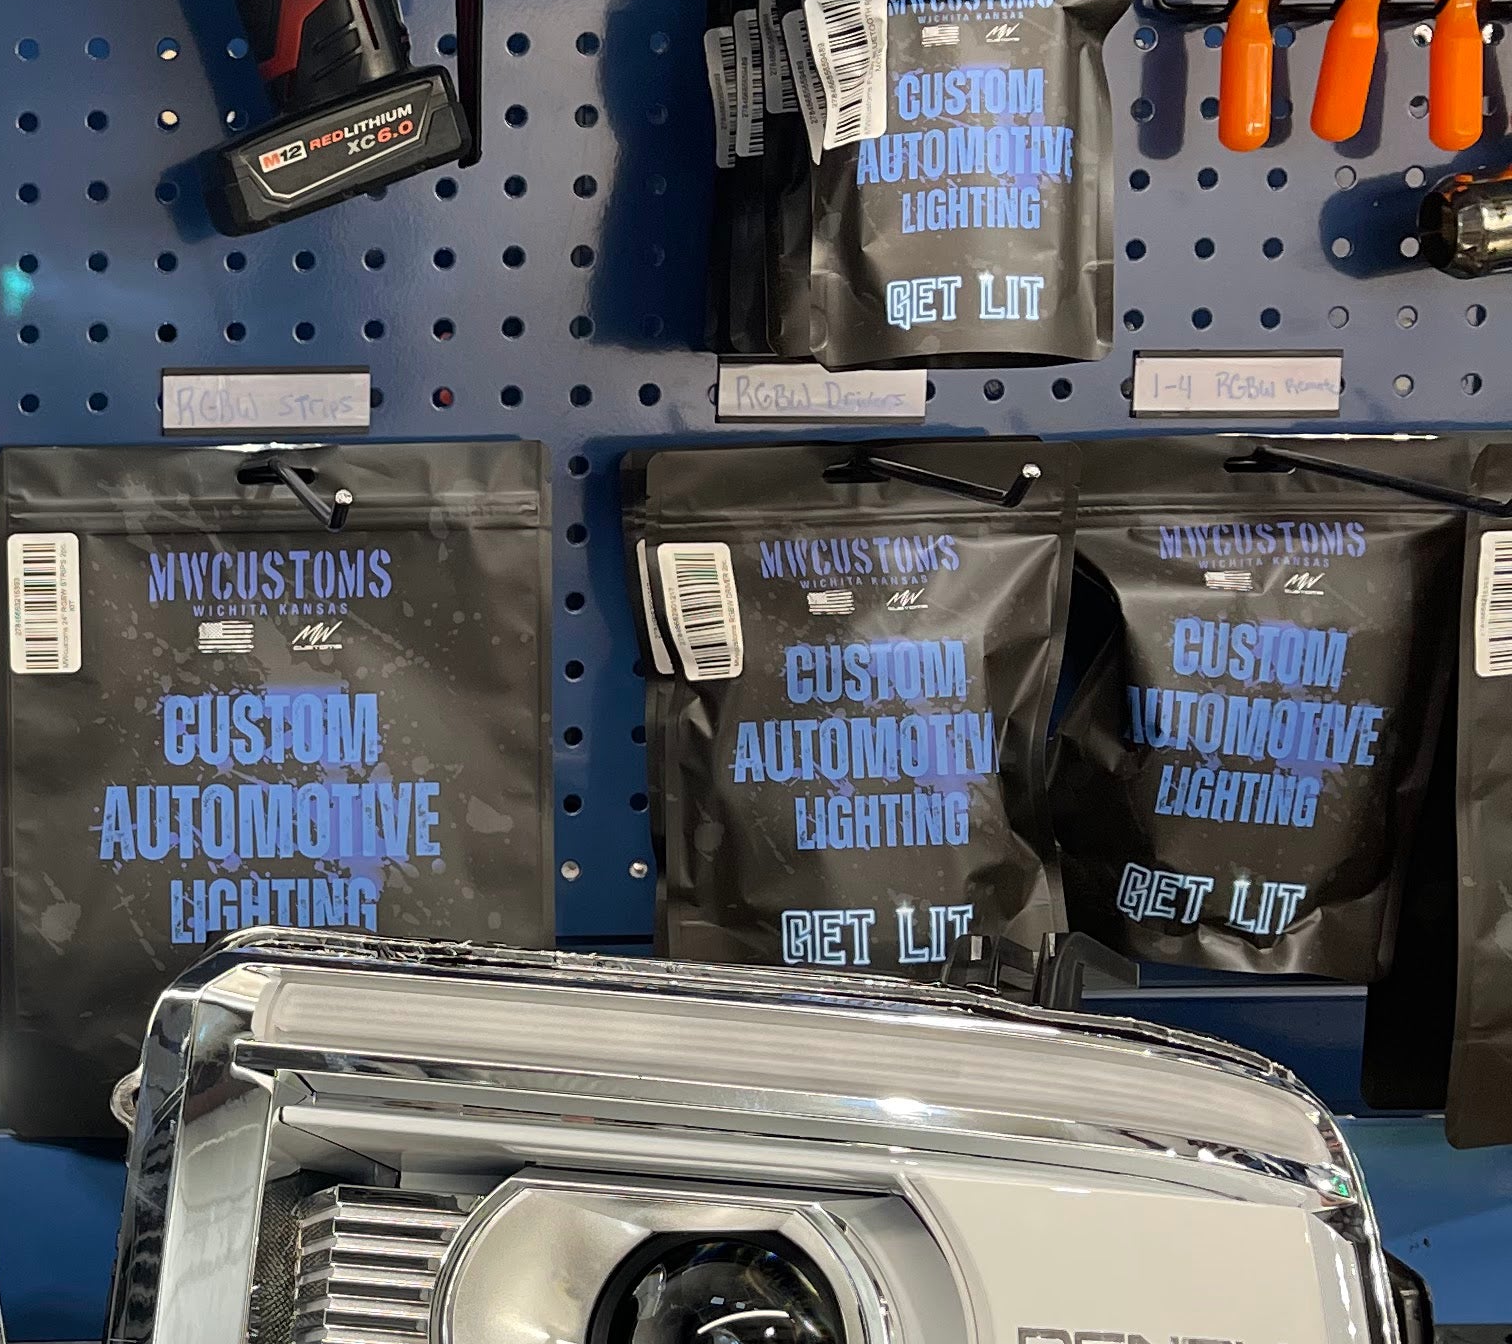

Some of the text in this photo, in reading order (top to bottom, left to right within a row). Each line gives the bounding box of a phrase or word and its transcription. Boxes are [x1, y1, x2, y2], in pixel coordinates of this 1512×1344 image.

[917, 11, 1025, 24] WICHITA KANSAS
[898, 68, 1045, 121] CUSTOM
[262, 104, 413, 169] M12 REDLITHIUM
[347, 120, 415, 156] XC6.0
[901, 186, 1042, 234] LIGHTING
[886, 272, 1046, 331] GET LIT
[176, 385, 260, 427] RGBW
[735, 374, 812, 411] RGBW
[1153, 372, 1193, 400] 1-4
[1215, 371, 1276, 401] RGBW
[759, 534, 961, 579] MWCUSTOMS
[1159, 521, 1367, 561] MWCUSTOMS
[1199, 556, 1331, 570] WICHITA KANSAS
[149, 549, 393, 602] MWCUSTOMS
[800, 574, 929, 590] WICHITA KANSAS
[193, 602, 349, 617] WICHITA KANSAS
[785, 640, 967, 704] CUSTOM
[1172, 616, 1348, 689] CUSTOM
[163, 692, 379, 765] CUSTOM
[734, 711, 1000, 784] AUTOMOTIV
[100, 781, 441, 861] AUTOMOTIVE
[794, 791, 970, 851] LIGHTING
[1154, 764, 1321, 828] LIGHTING
[170, 876, 379, 944] LIGHTING
[1116, 862, 1307, 936] GET LIT
[781, 902, 974, 966] GET LIT
